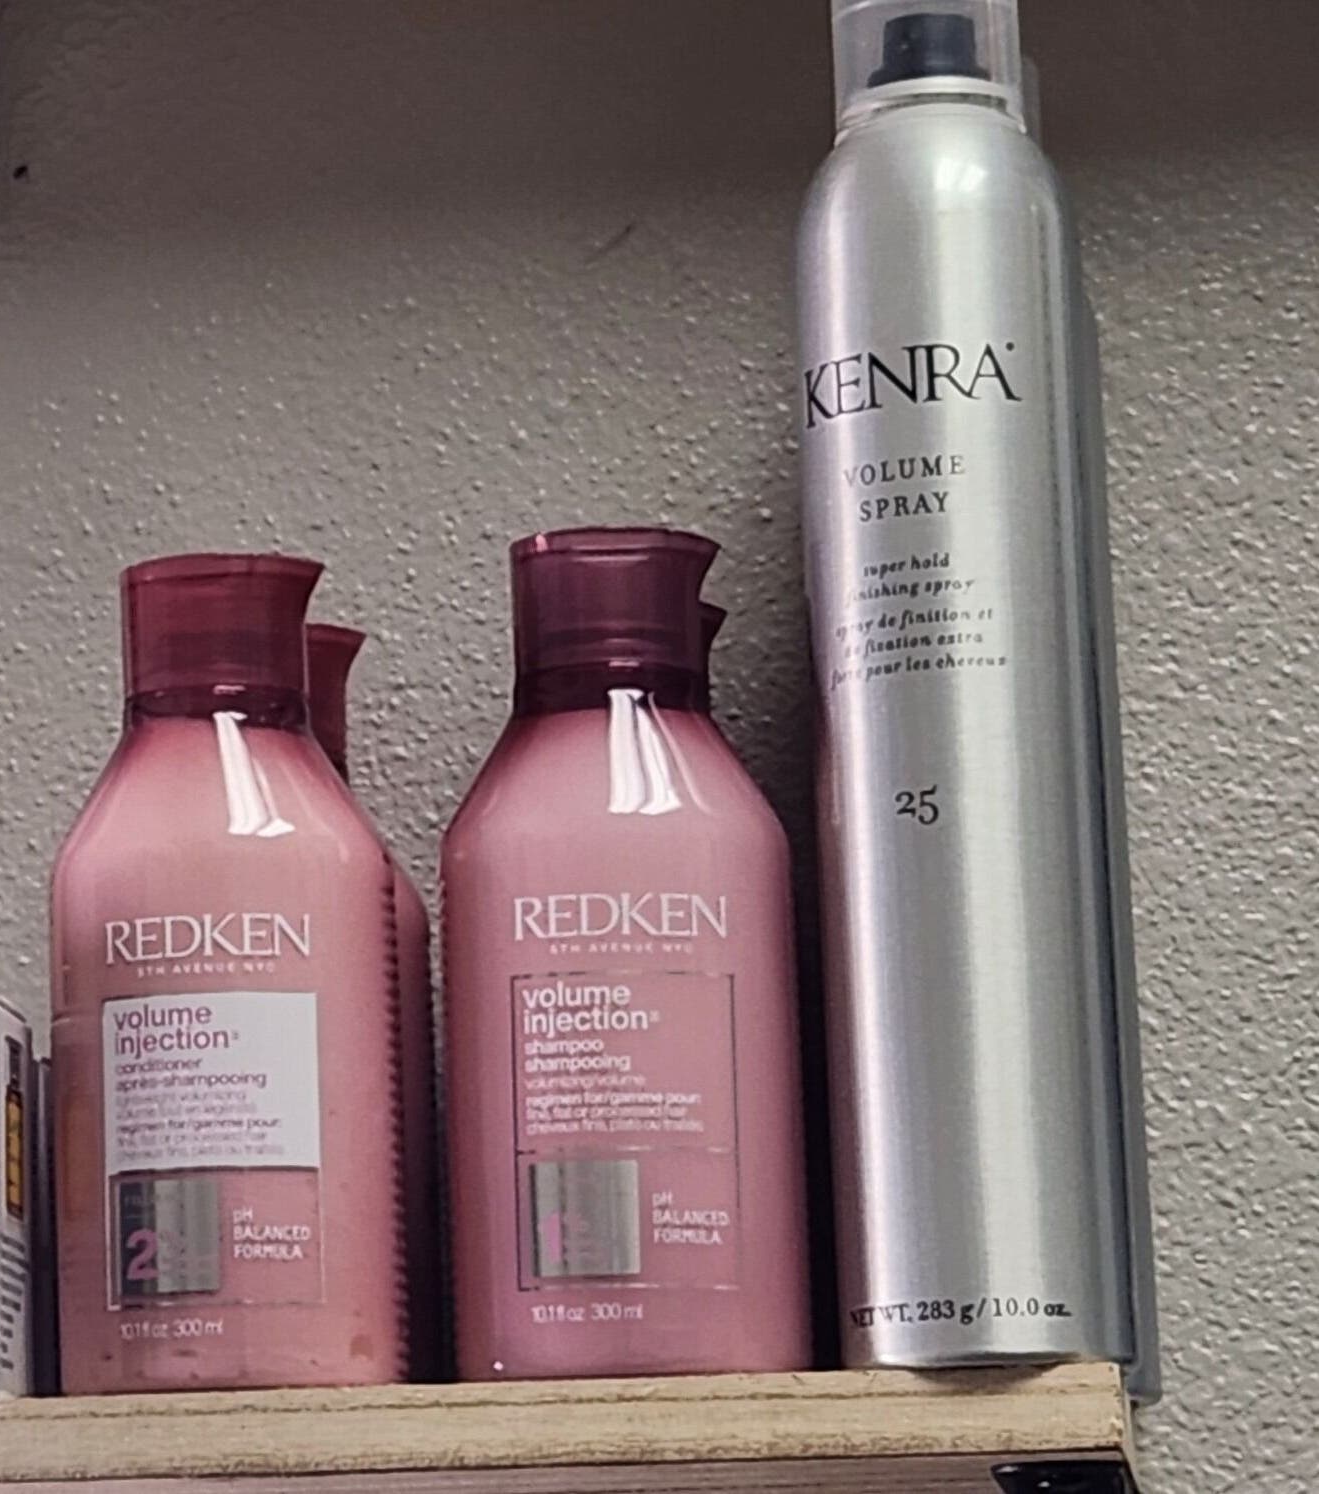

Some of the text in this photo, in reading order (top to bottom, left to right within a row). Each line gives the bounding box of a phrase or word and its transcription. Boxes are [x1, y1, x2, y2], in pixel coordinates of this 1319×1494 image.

[804, 342, 1023, 429] KENRA
[844, 455, 966, 488] VOLUME
[859, 491, 949, 523] SPRAY
[910, 551, 950, 571] hold
[844, 578, 975, 609] nishing spray
[835, 619, 874, 643] spay
[865, 660, 903, 683] pour
[905, 654, 932, 673] les
[894, 784, 940, 825] 25
[511, 892, 727, 941] REDKEN
[104, 912, 311, 965] REDKEN
[522, 981, 631, 1008] volume
[113, 1004, 213, 1031] volume
[523, 1008, 649, 1038] injection
[114, 1027, 230, 1060] injection
[524, 1039, 605, 1055] shampoo
[114, 1057, 203, 1076] conditioner
[524, 1055, 631, 1073] shampooing
[232, 1205, 254, 1223] pH
[652, 1209, 730, 1227] BALANCED
[232, 1224, 312, 1242] BALANCED
[653, 1228, 724, 1246] FORMULA
[233, 1242, 304, 1261] FORMULA
[590, 1301, 622, 1321] 300
[916, 1298, 956, 1322] 283
[992, 1297, 1039, 1318] 10.0
[172, 1317, 204, 1338] 300
